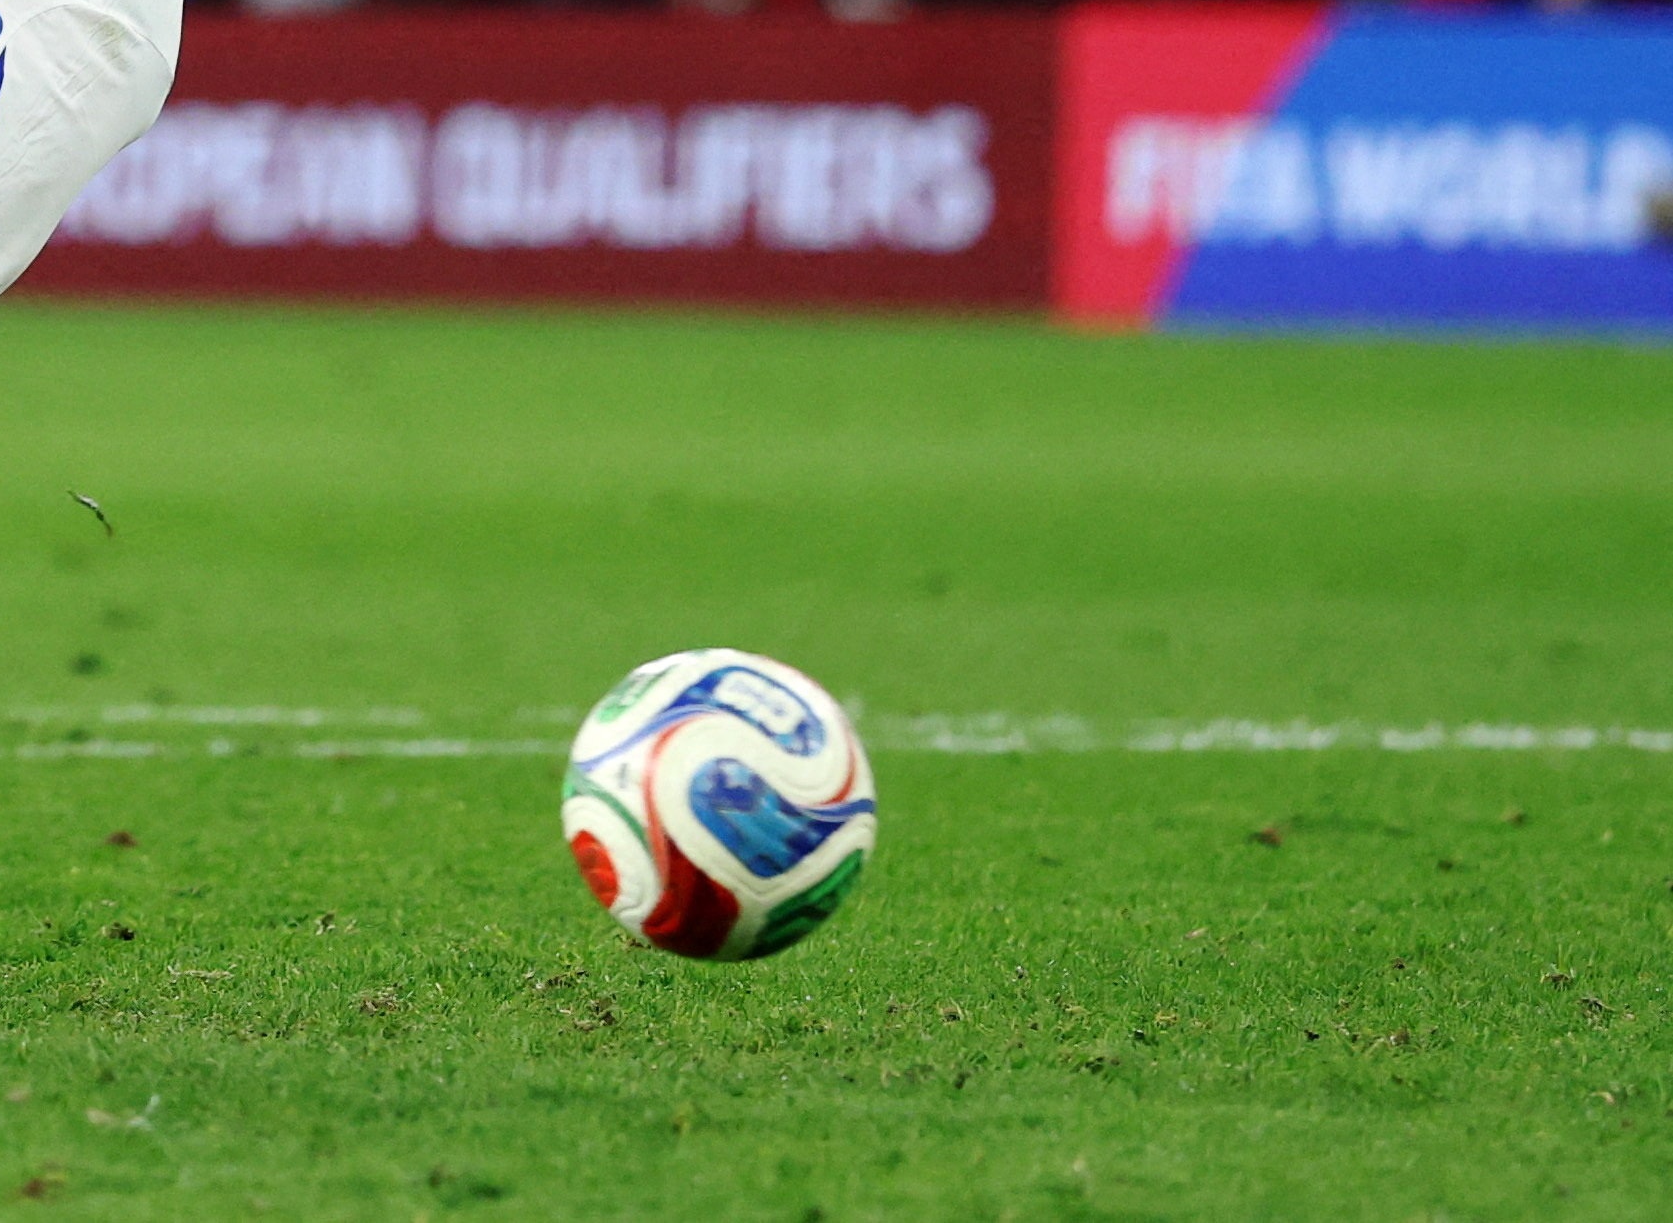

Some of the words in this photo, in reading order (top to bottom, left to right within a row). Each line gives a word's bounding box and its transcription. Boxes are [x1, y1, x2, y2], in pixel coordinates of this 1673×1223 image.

[60, 105, 421, 244] OPEAN
[433, 104, 992, 250] QUALIFIERS
[1108, 118, 1316, 242] FIFA
